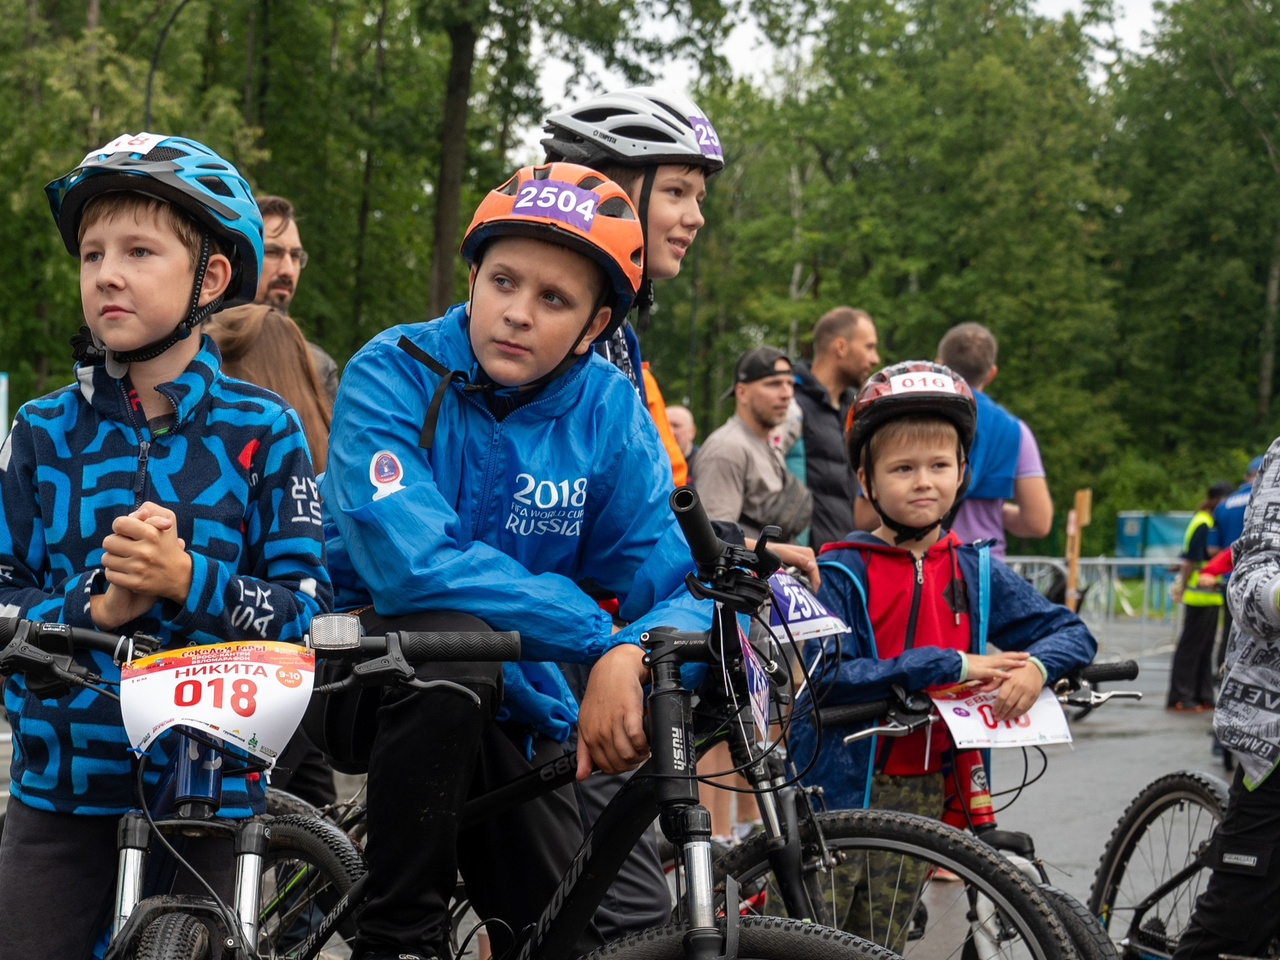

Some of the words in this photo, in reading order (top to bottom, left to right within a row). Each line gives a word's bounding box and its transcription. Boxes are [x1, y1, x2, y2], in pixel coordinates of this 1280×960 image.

[514, 186, 595, 222] 2504
[902, 377, 945, 388] 016
[513, 473, 587, 509] 2018
[511, 501, 527, 517] FIFA
[530, 510, 564, 519] WORLD
[567, 510, 585, 519] CUP
[505, 512, 582, 537] RUSSIA
[192, 651, 250, 660] КРОСС-КАНТРИ
[192, 656, 250, 665] ВЕЛОМАРАФОН
[175, 664, 268, 679] НИКИТА
[278, 671, 300, 680] 9-10
[173, 677, 258, 718] 018
